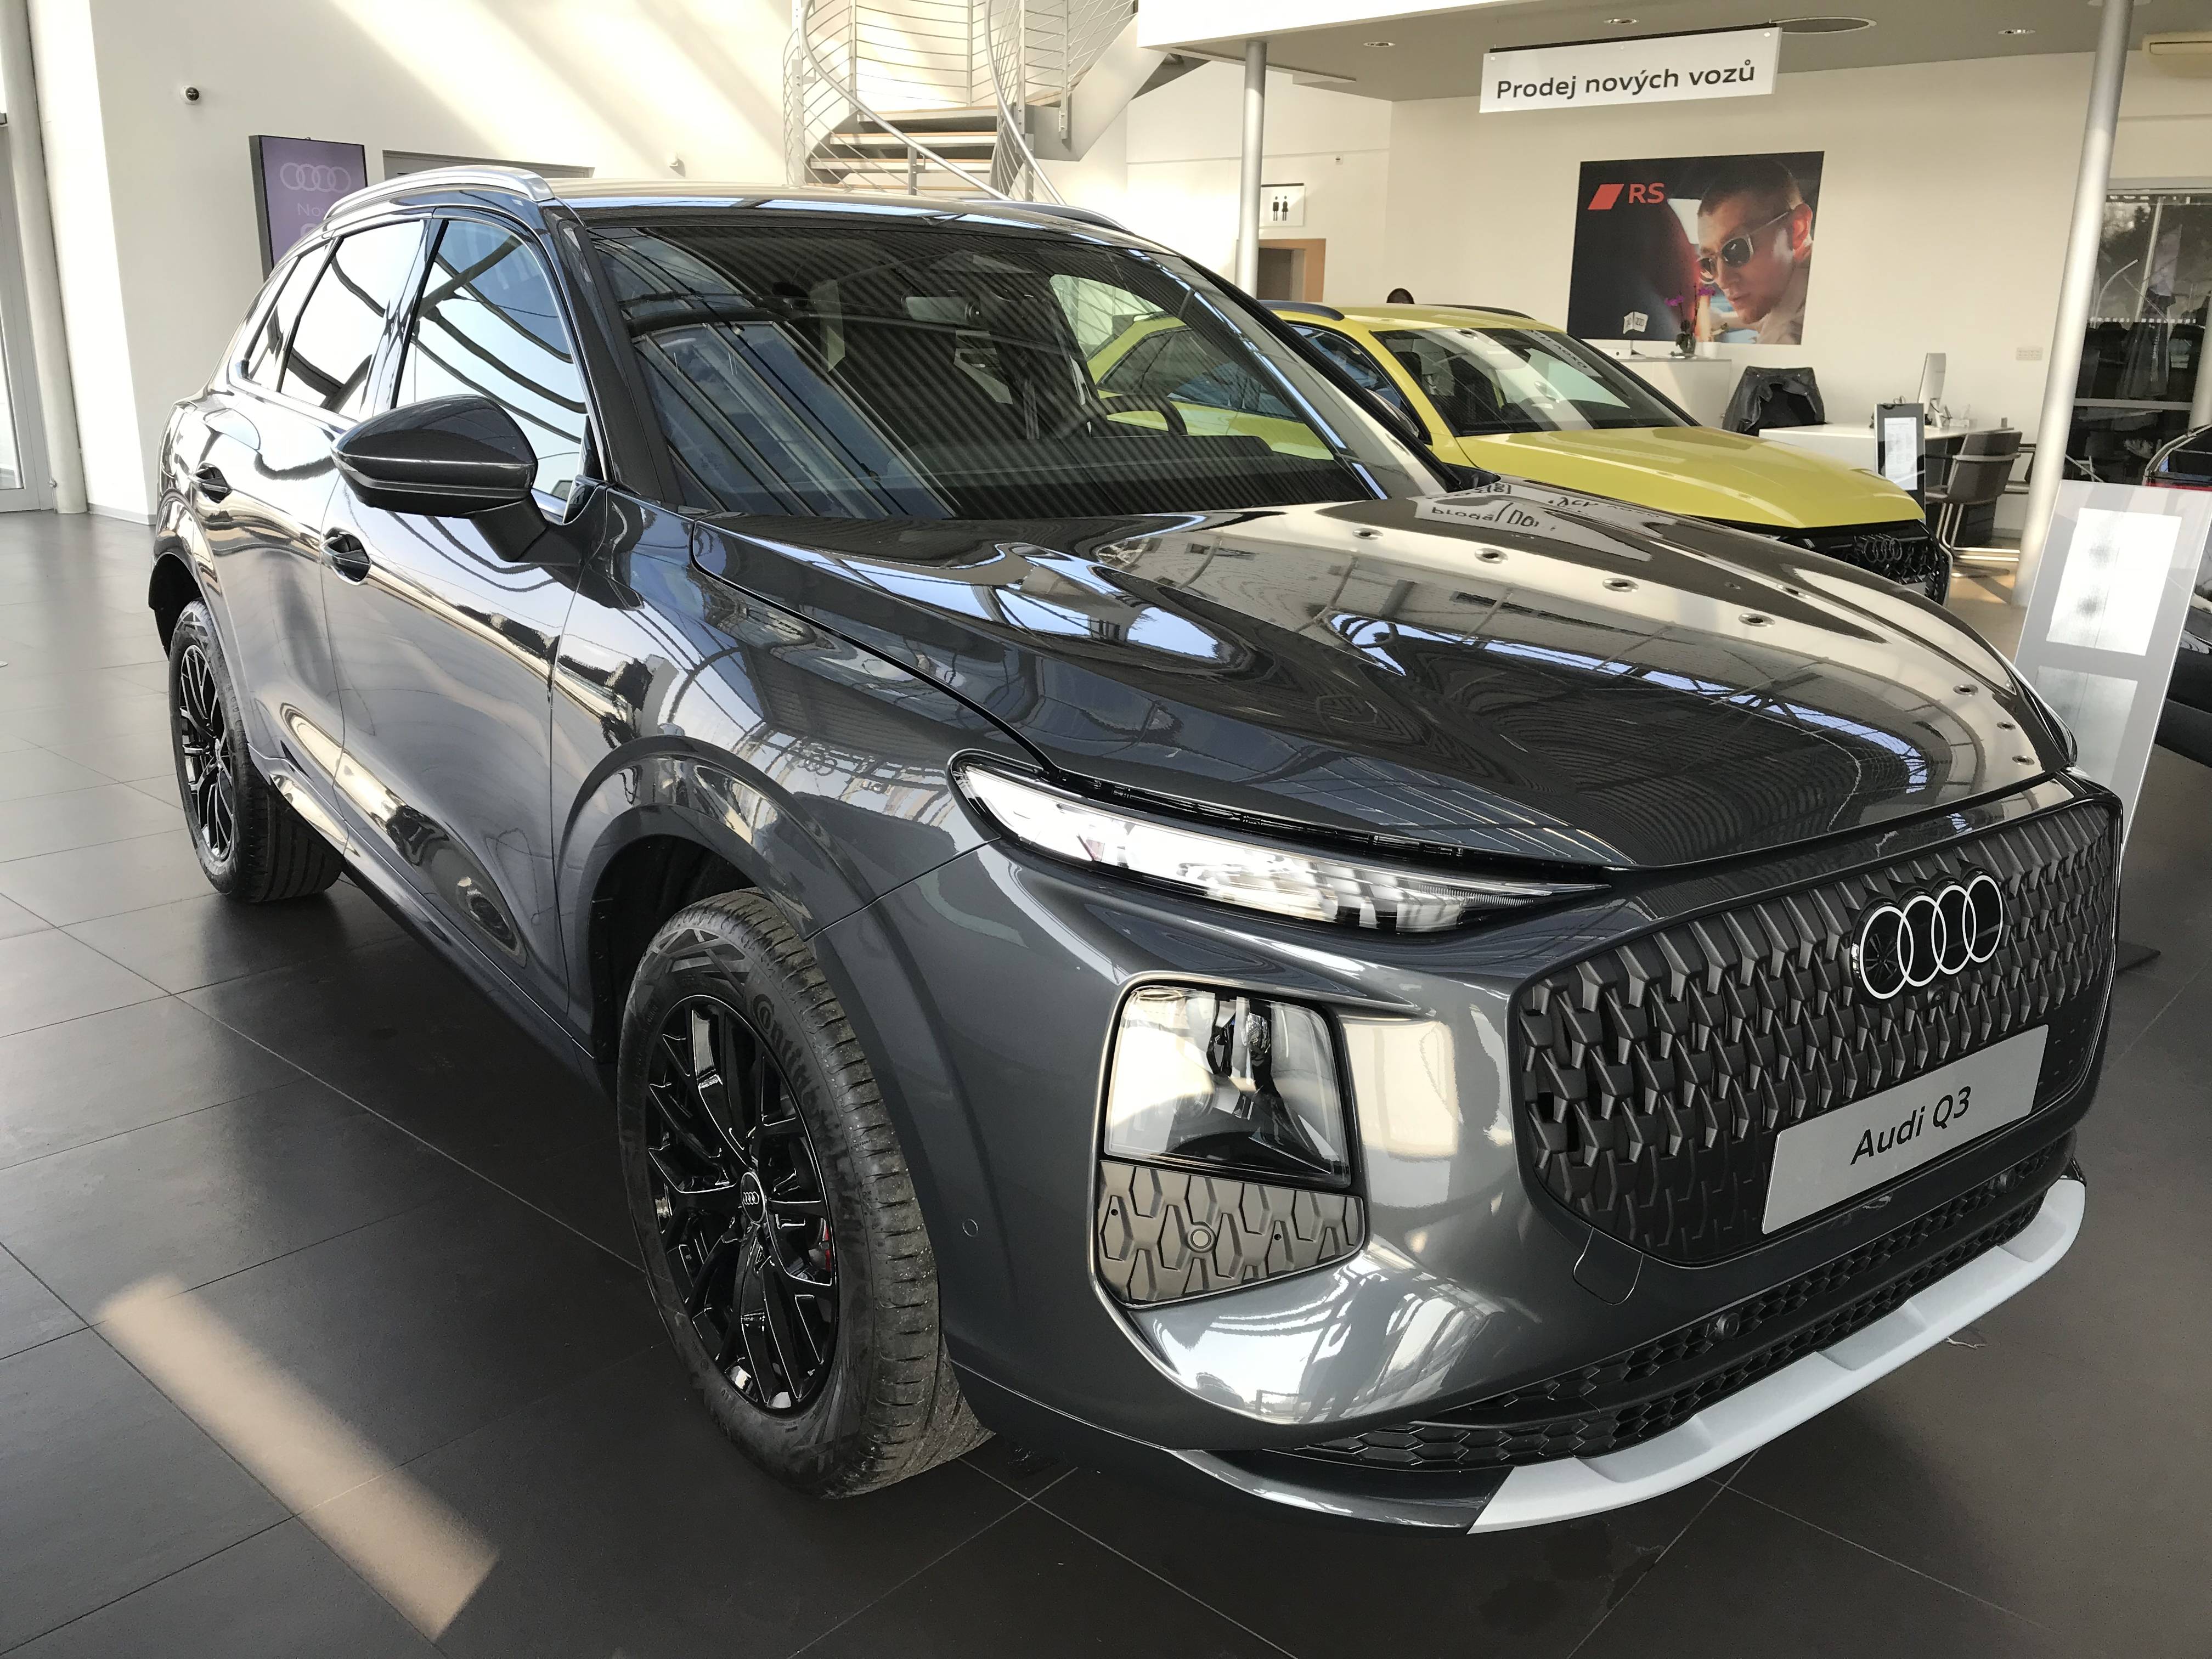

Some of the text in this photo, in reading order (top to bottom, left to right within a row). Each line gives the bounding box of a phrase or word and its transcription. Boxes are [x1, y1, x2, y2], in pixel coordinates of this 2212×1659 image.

[1497, 59, 1755, 99] Prodej nových vozů
[1628, 183, 1665, 204] RS
[1850, 1086, 1972, 1165] Audi Q3
